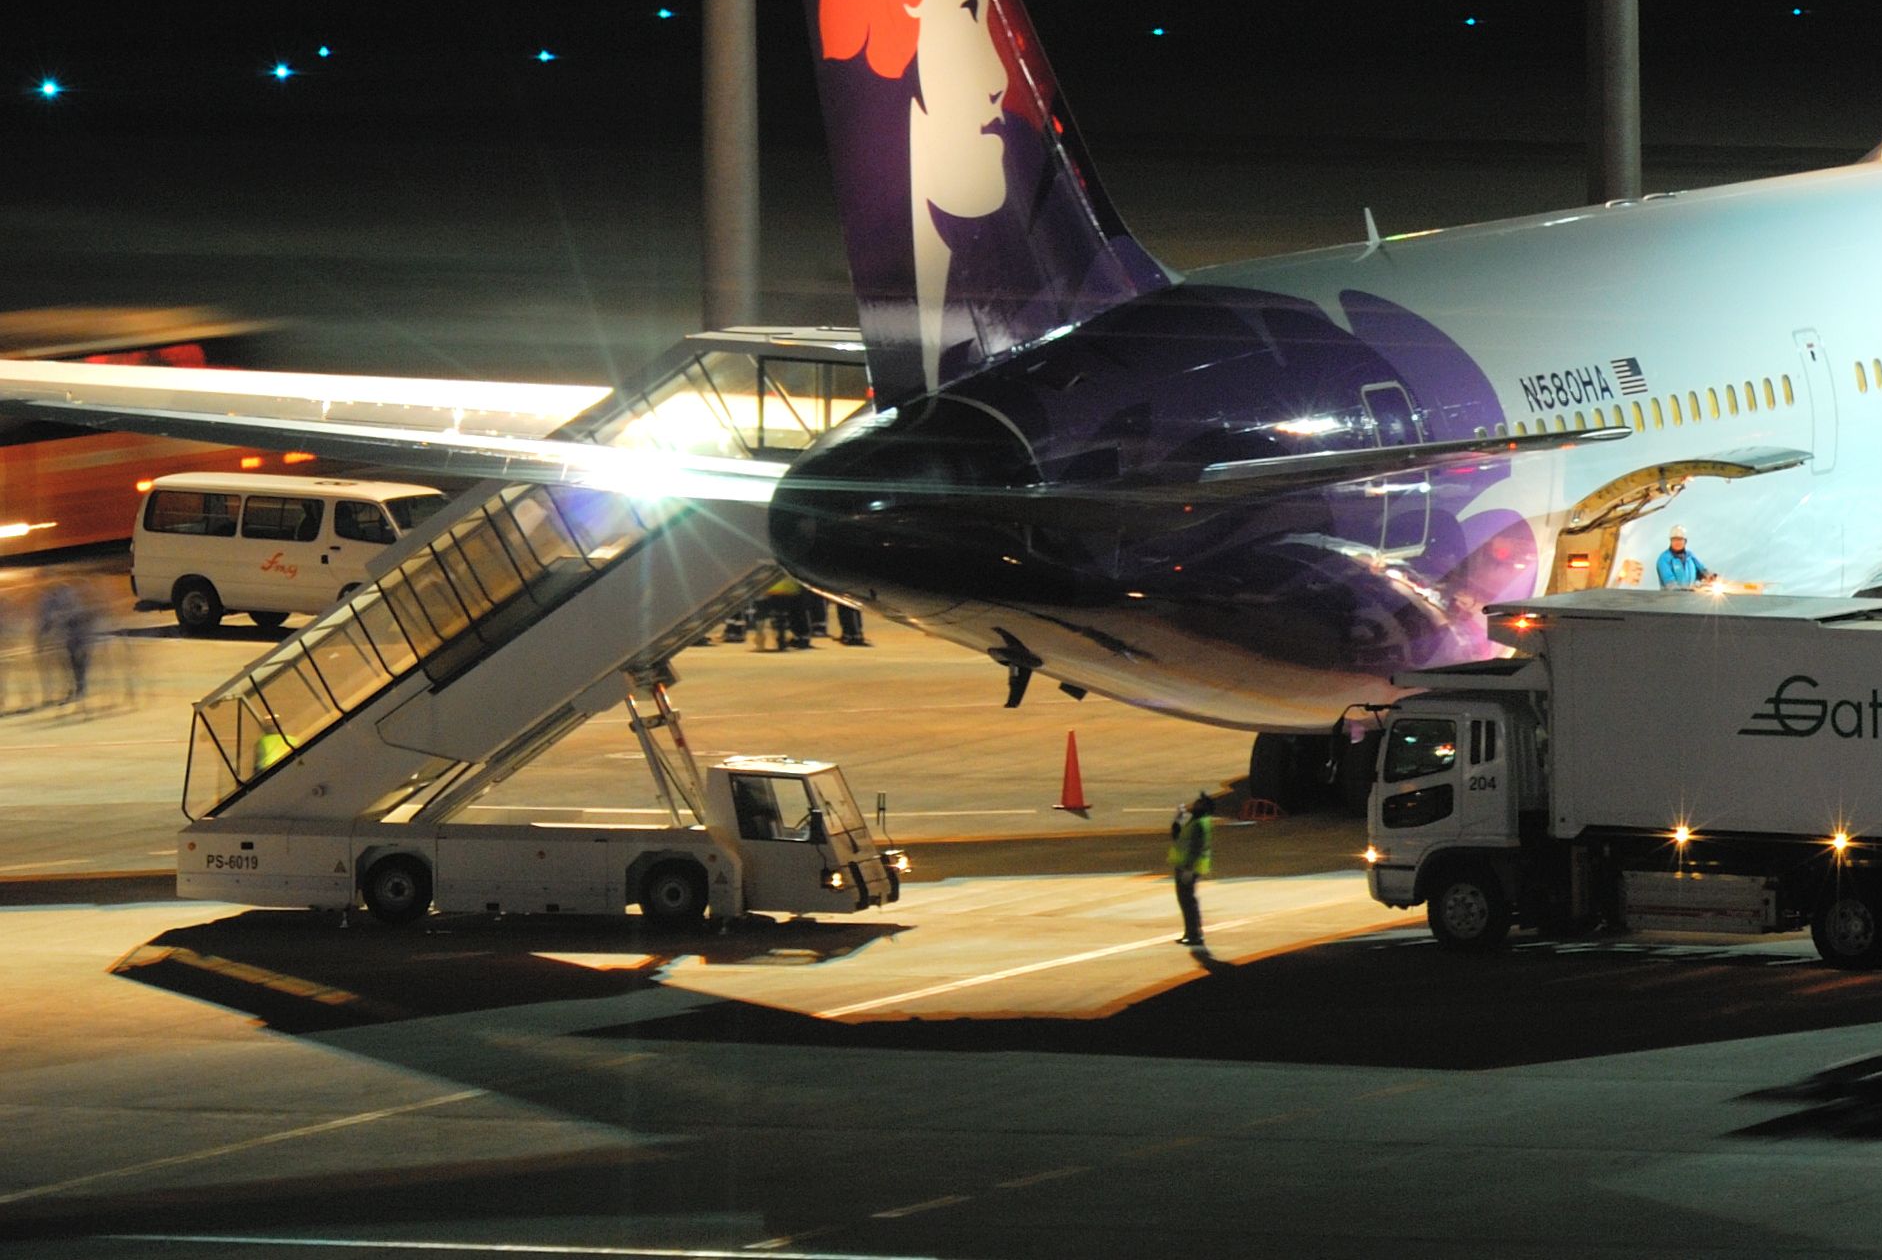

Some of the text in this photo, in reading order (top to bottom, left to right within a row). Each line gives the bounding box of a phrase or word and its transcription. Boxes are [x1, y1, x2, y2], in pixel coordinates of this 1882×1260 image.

[1520, 365, 1614, 413] N580HA
[1469, 776, 1496, 790] 204
[206, 854, 258, 870] PS-6019
